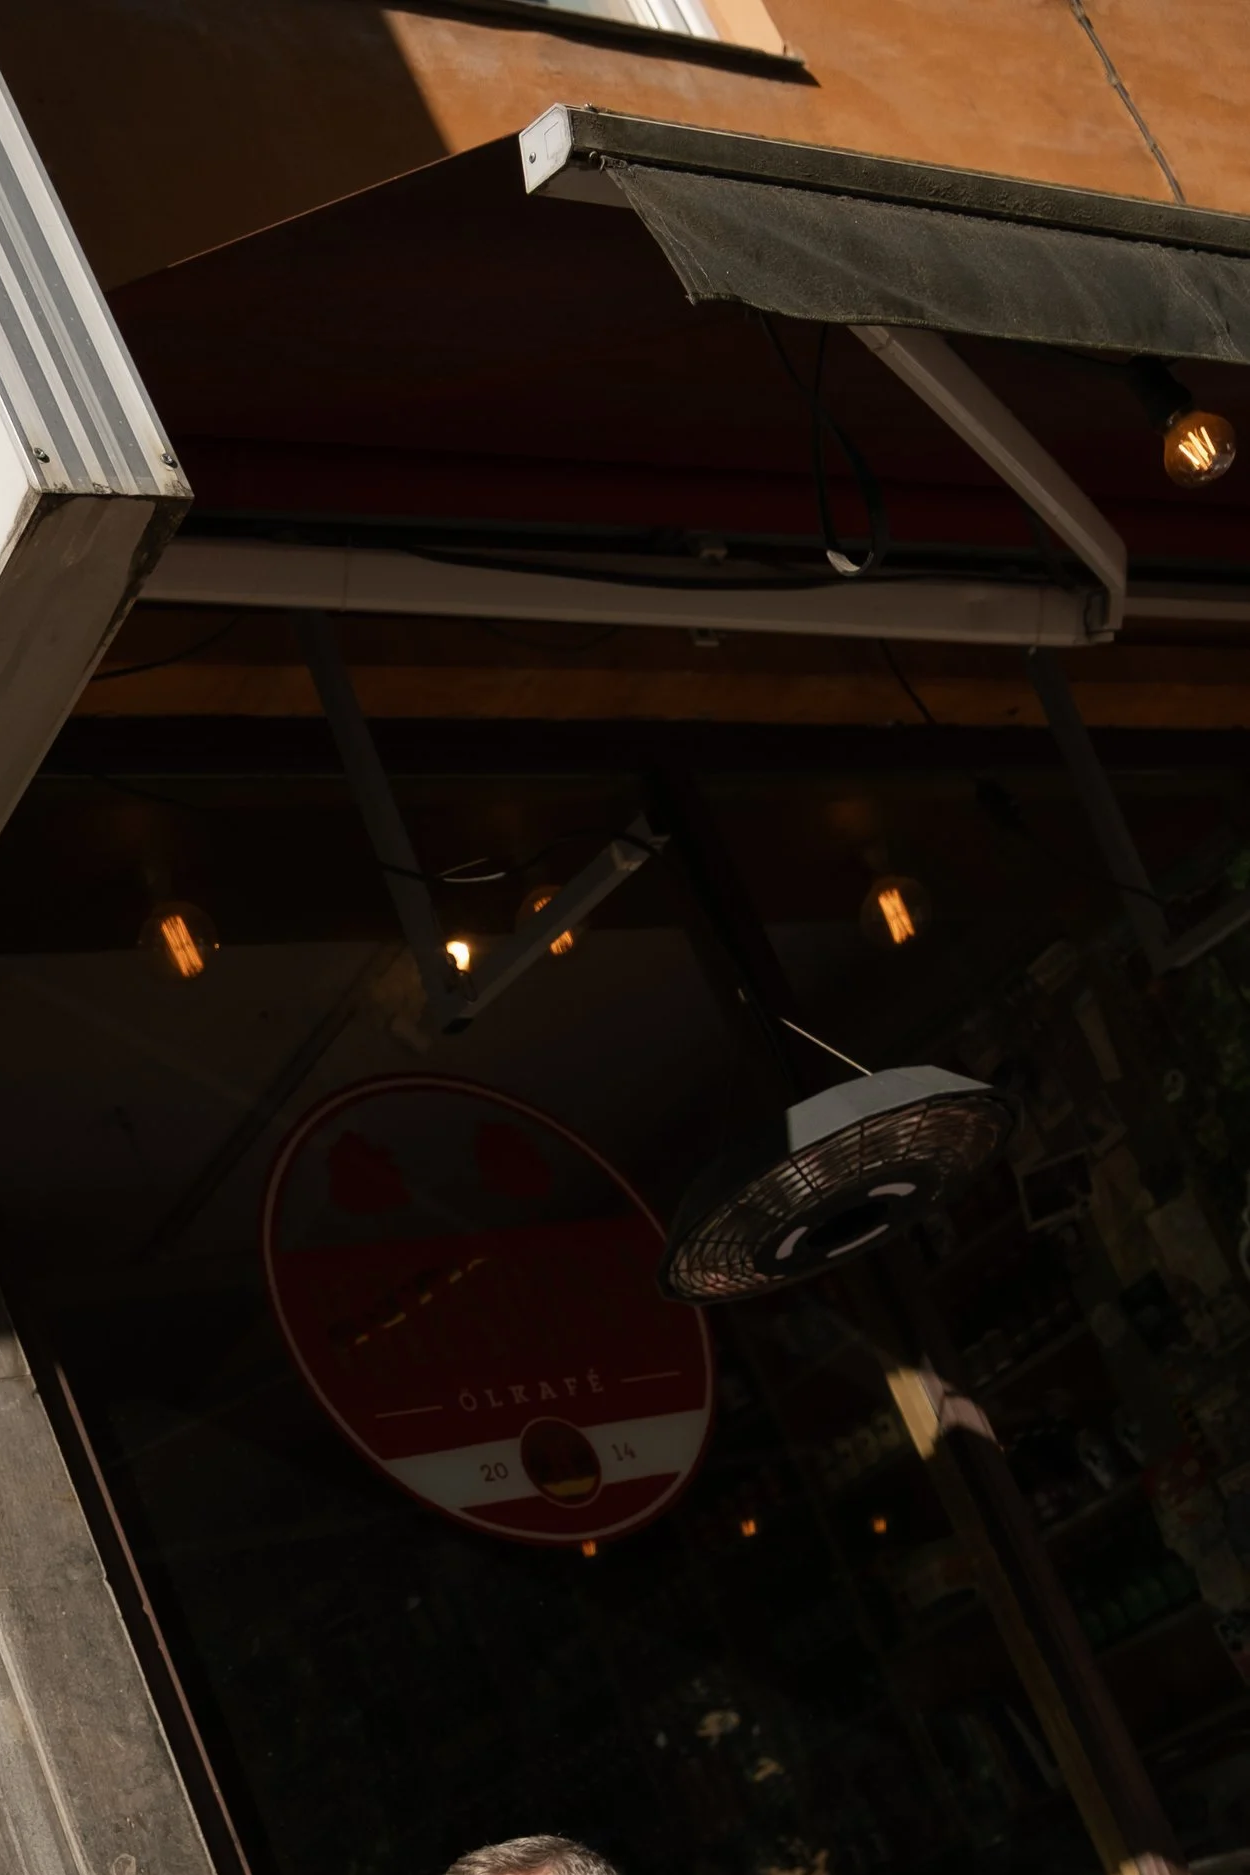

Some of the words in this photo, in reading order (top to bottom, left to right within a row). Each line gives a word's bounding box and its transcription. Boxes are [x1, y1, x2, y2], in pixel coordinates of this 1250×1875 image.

[458, 1367, 606, 1412] ÖLKAFÉ
[479, 1462, 509, 1484] 20
[611, 1443, 637, 1463] 14
